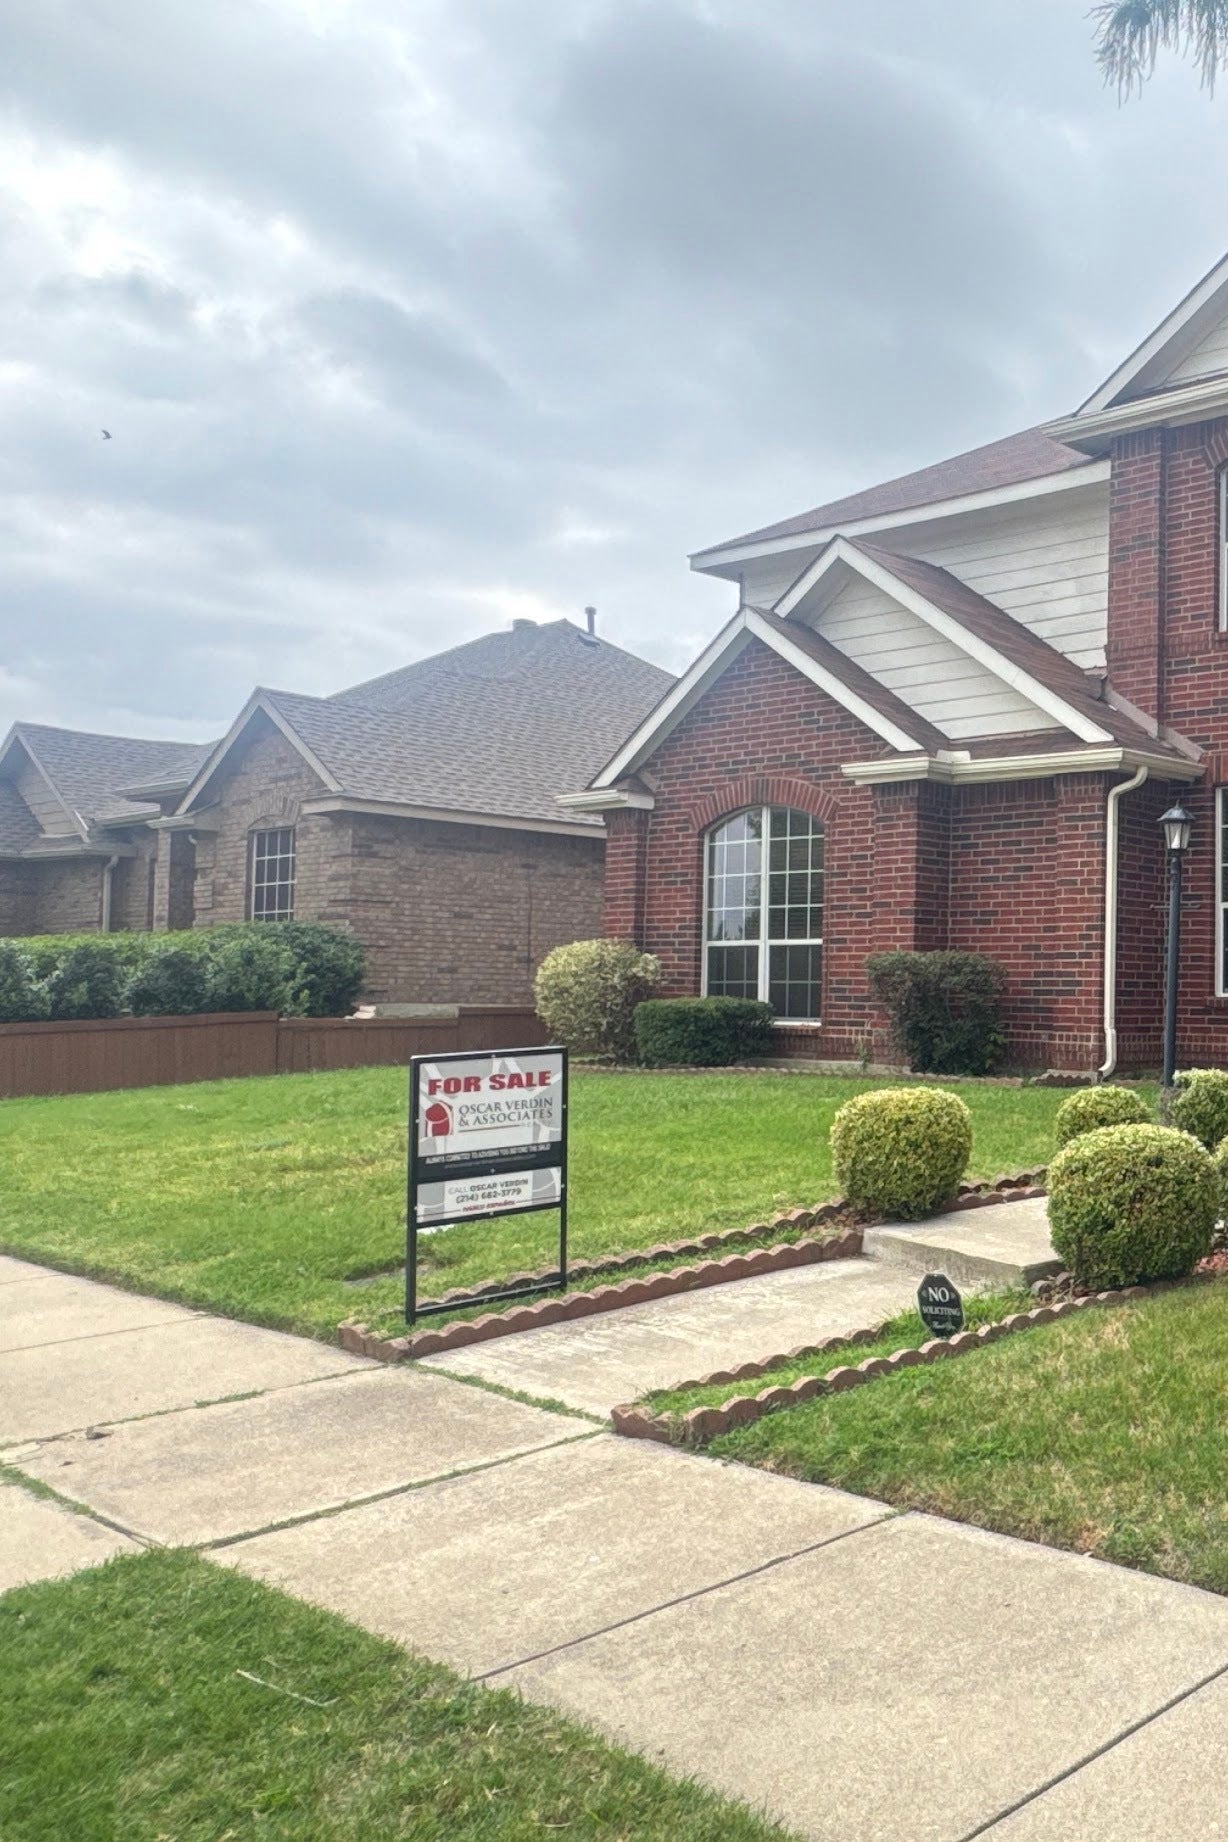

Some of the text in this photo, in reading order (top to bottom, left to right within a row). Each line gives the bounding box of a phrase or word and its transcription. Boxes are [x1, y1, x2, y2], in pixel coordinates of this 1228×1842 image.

[428, 1071, 552, 1095] FOR SALE
[459, 1097, 553, 1115] OSCAR VERDIN
[458, 1117, 469, 1127] &
[473, 1111, 553, 1126] ASSOCIATES
[448, 1179, 528, 1194] CALL OSCAR VERDIN
[456, 1194, 478, 1203] (214)
[928, 1286, 950, 1302] NO
